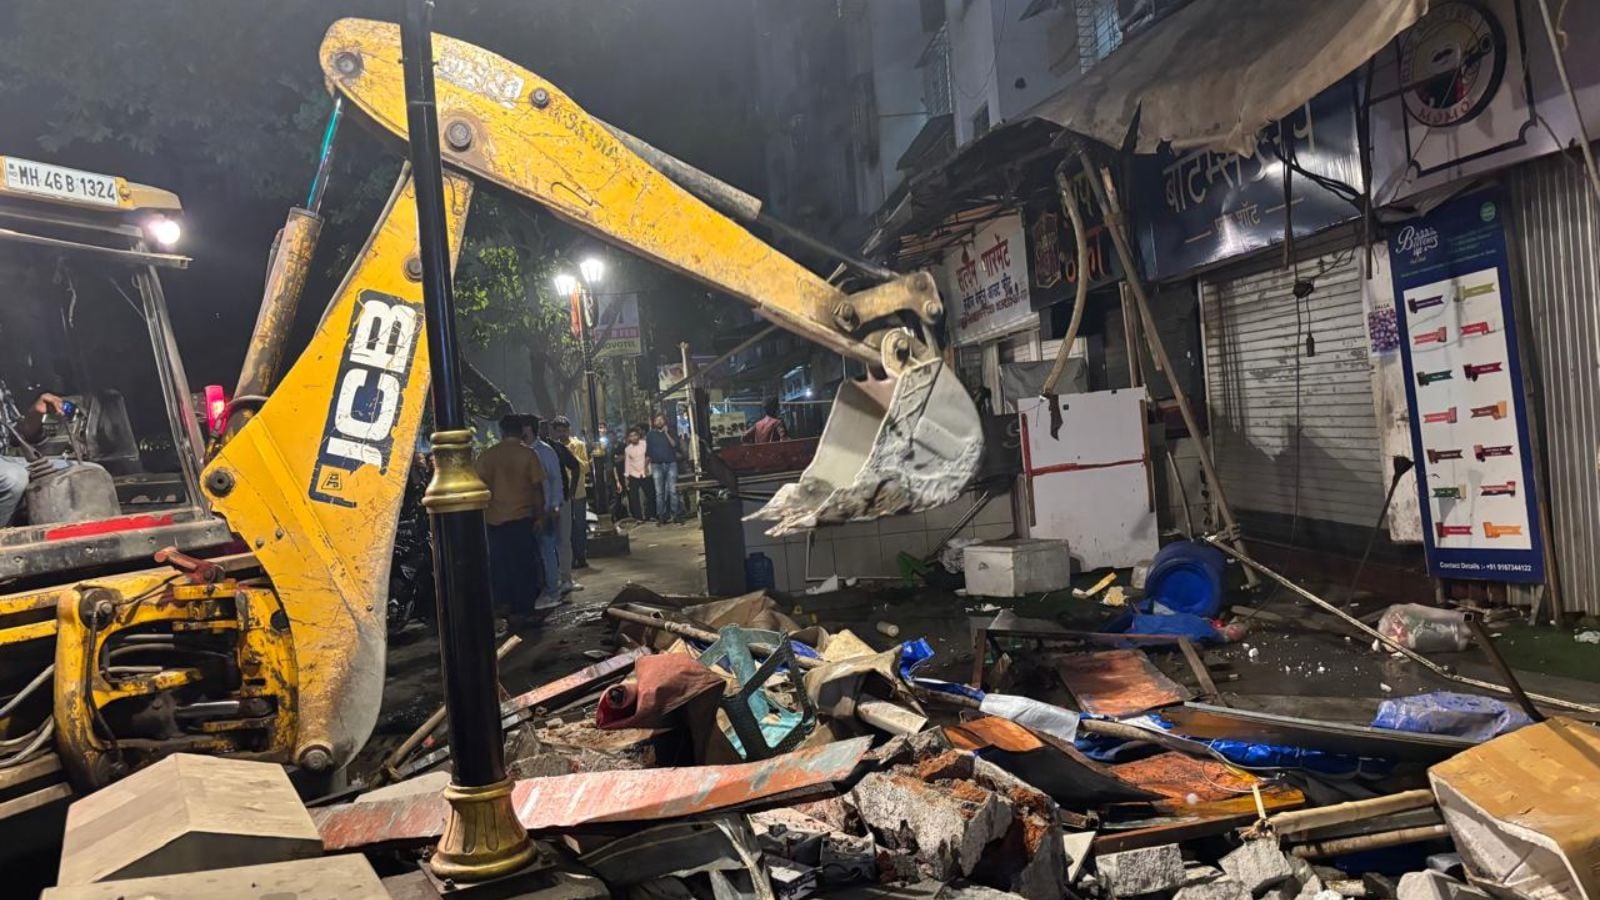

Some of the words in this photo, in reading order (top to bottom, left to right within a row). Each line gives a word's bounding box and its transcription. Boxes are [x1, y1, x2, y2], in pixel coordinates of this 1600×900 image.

[18, 165, 40, 187] MH
[44, 171, 63, 190] 46
[66, 175, 75, 193] B
[80, 178, 116, 200] 1324
[326, 300, 417, 467] JCB
[1439, 561, 1460, 569] Contact
[1461, 562, 1480, 570] Details
